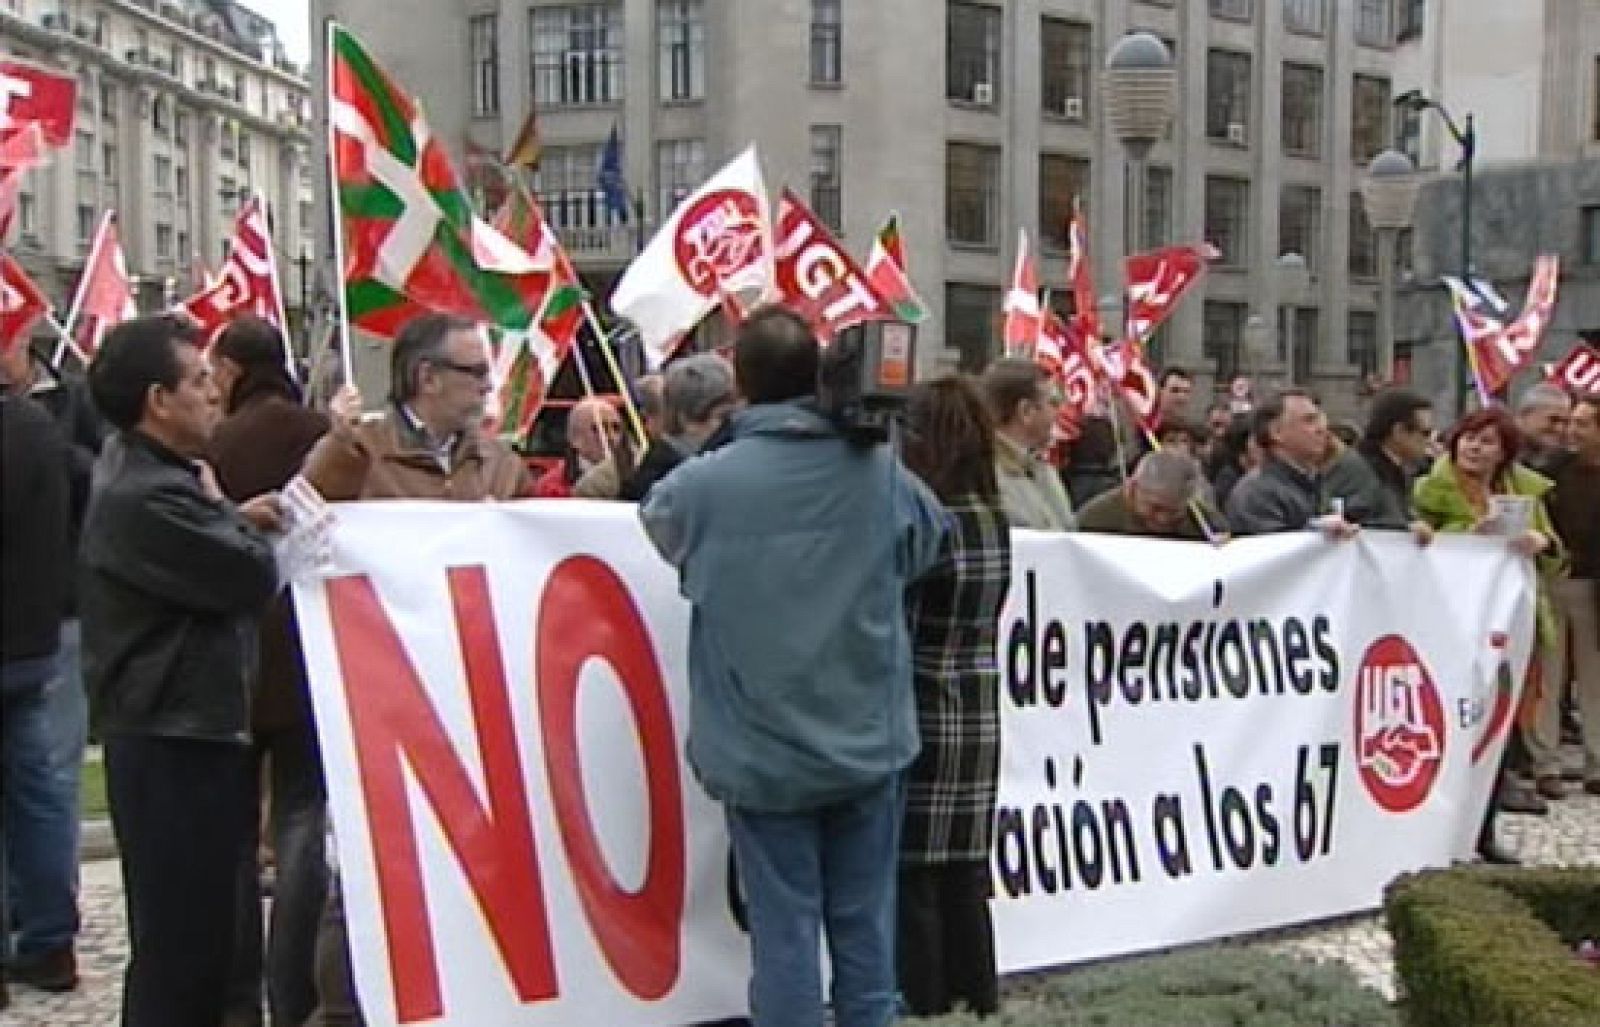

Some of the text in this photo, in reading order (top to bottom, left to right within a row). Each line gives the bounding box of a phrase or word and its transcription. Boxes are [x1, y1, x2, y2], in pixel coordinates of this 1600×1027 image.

[1007, 571, 1338, 744] de pensiones
[1364, 665, 1424, 735] UGT
[325, 554, 685, 1024] NO
[990, 742, 1341, 899] ación a los 67
